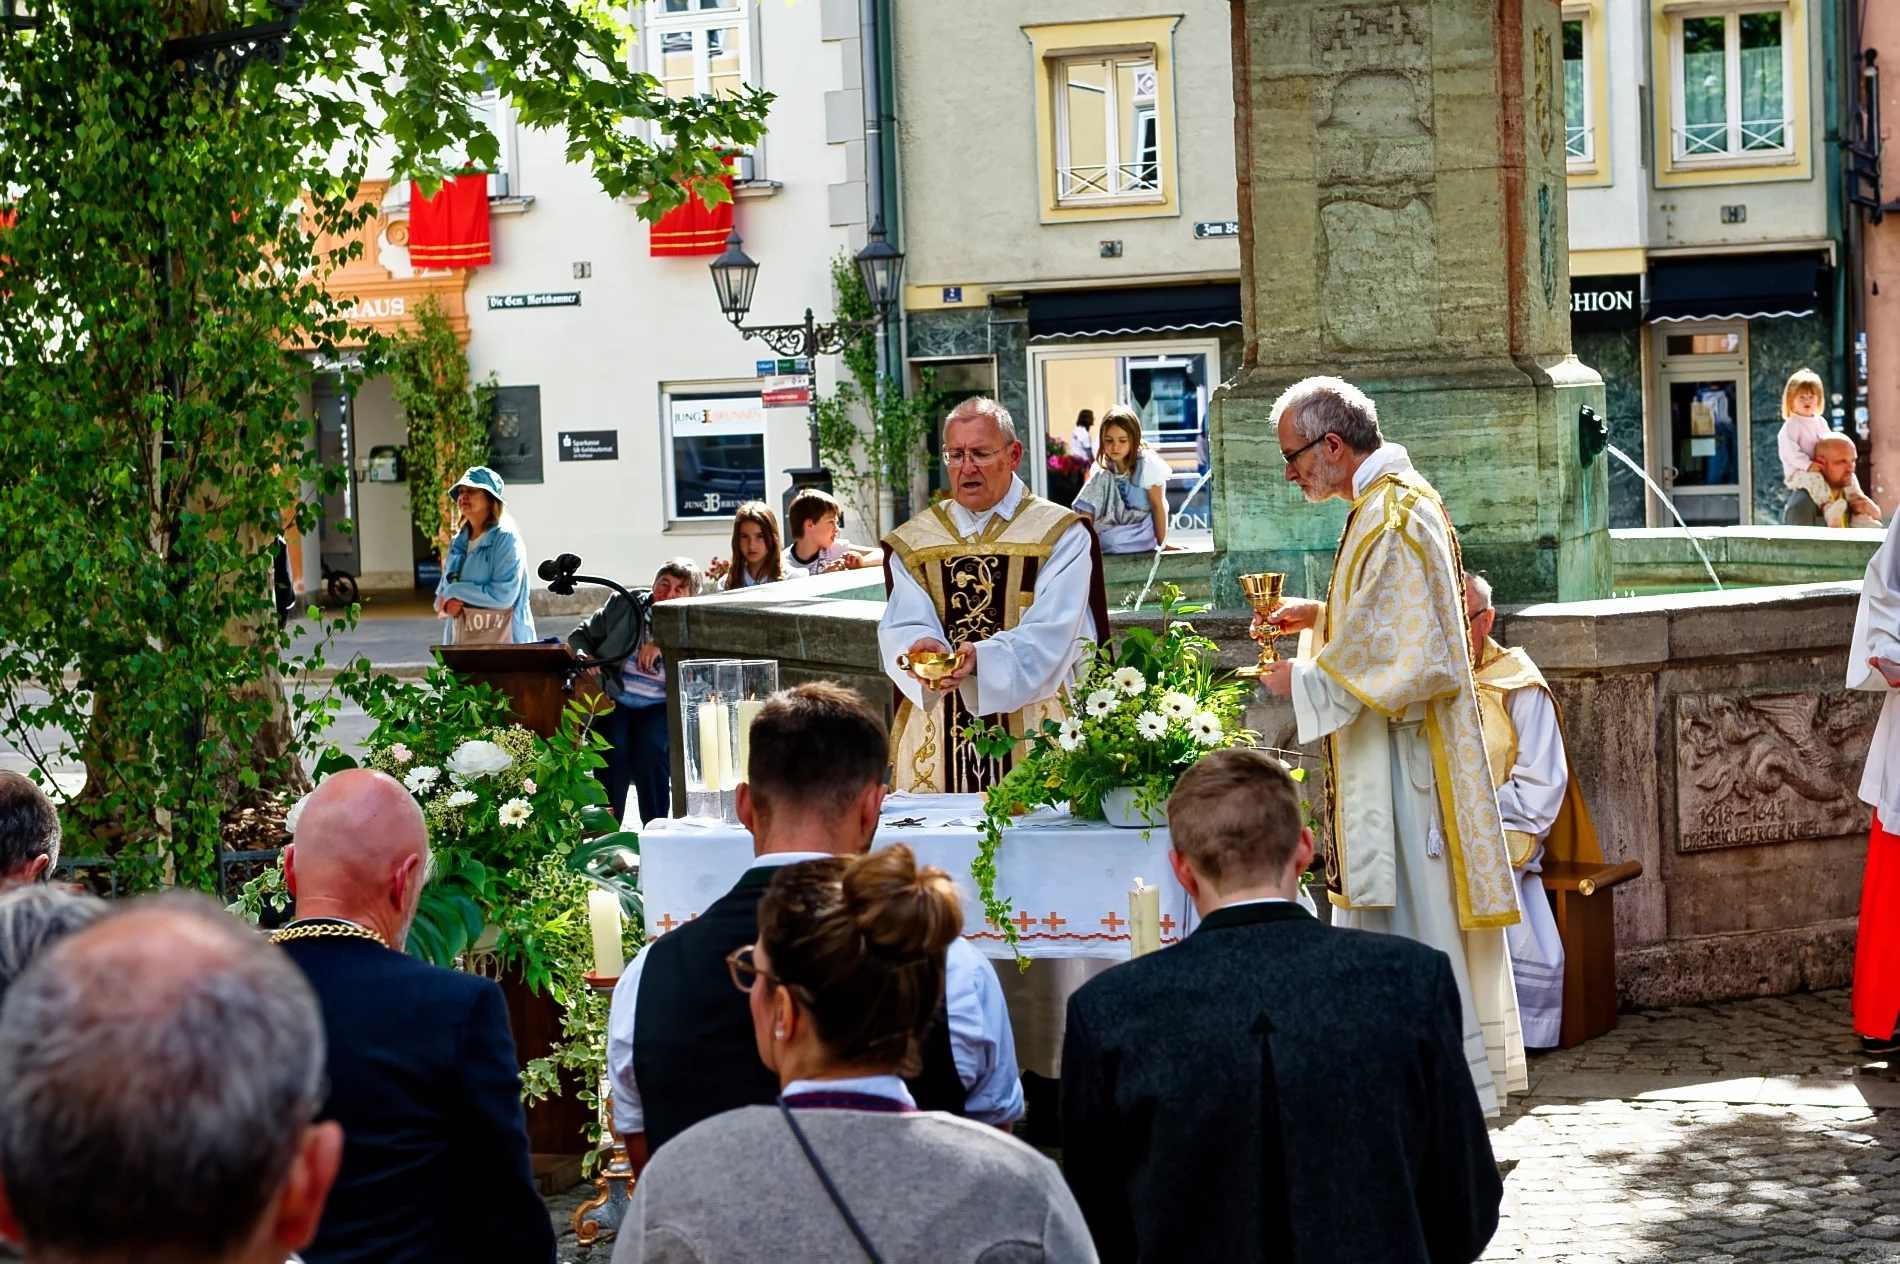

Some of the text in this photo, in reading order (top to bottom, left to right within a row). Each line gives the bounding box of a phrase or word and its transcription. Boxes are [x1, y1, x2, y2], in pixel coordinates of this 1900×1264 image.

[490, 297, 504, 307] Die
[1569, 290, 1633, 312] HION
[675, 412, 701, 424] JUNG
[684, 501, 705, 509] JUNG
